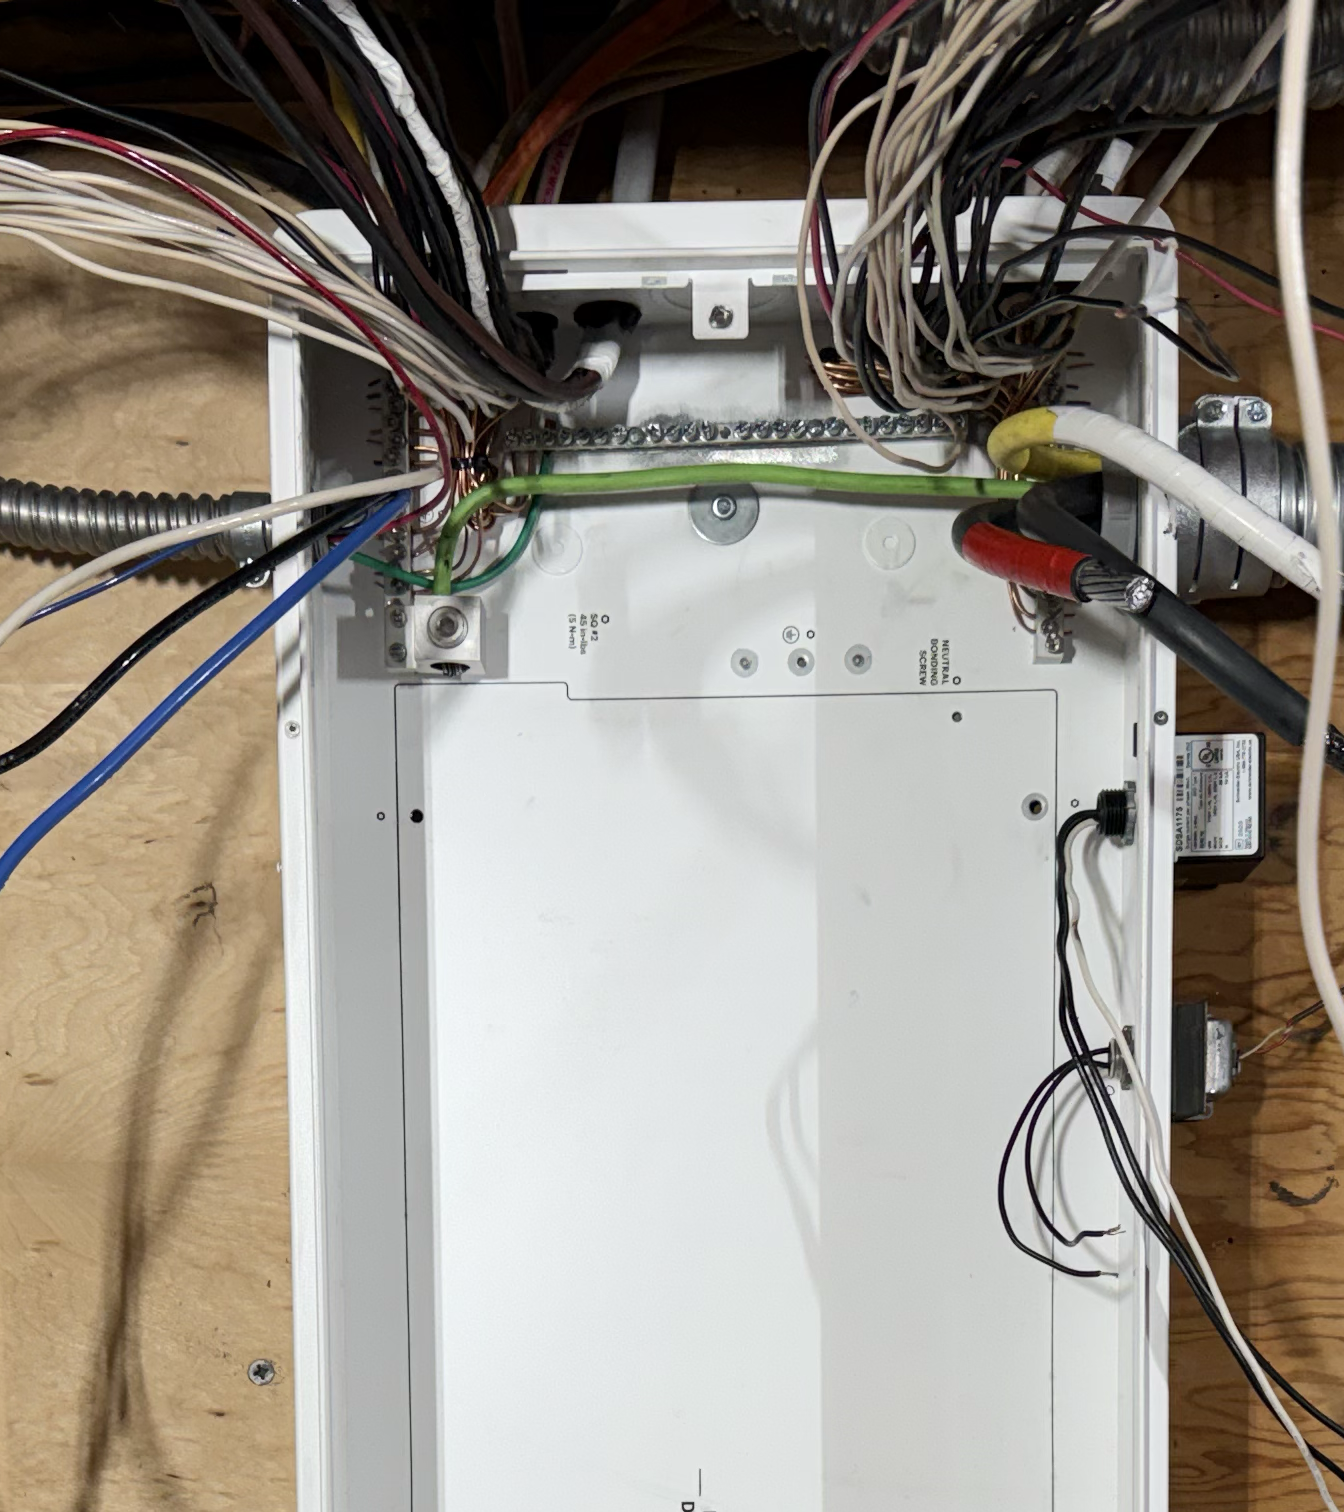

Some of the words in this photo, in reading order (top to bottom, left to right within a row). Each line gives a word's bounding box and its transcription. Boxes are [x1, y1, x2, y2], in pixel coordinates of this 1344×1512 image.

[568, 614, 576, 623] (5
[580, 614, 587, 626] 45
[590, 614, 598, 628] SQ
[919, 650, 927, 686] SCREW
[930, 638, 938, 686] BONDING
